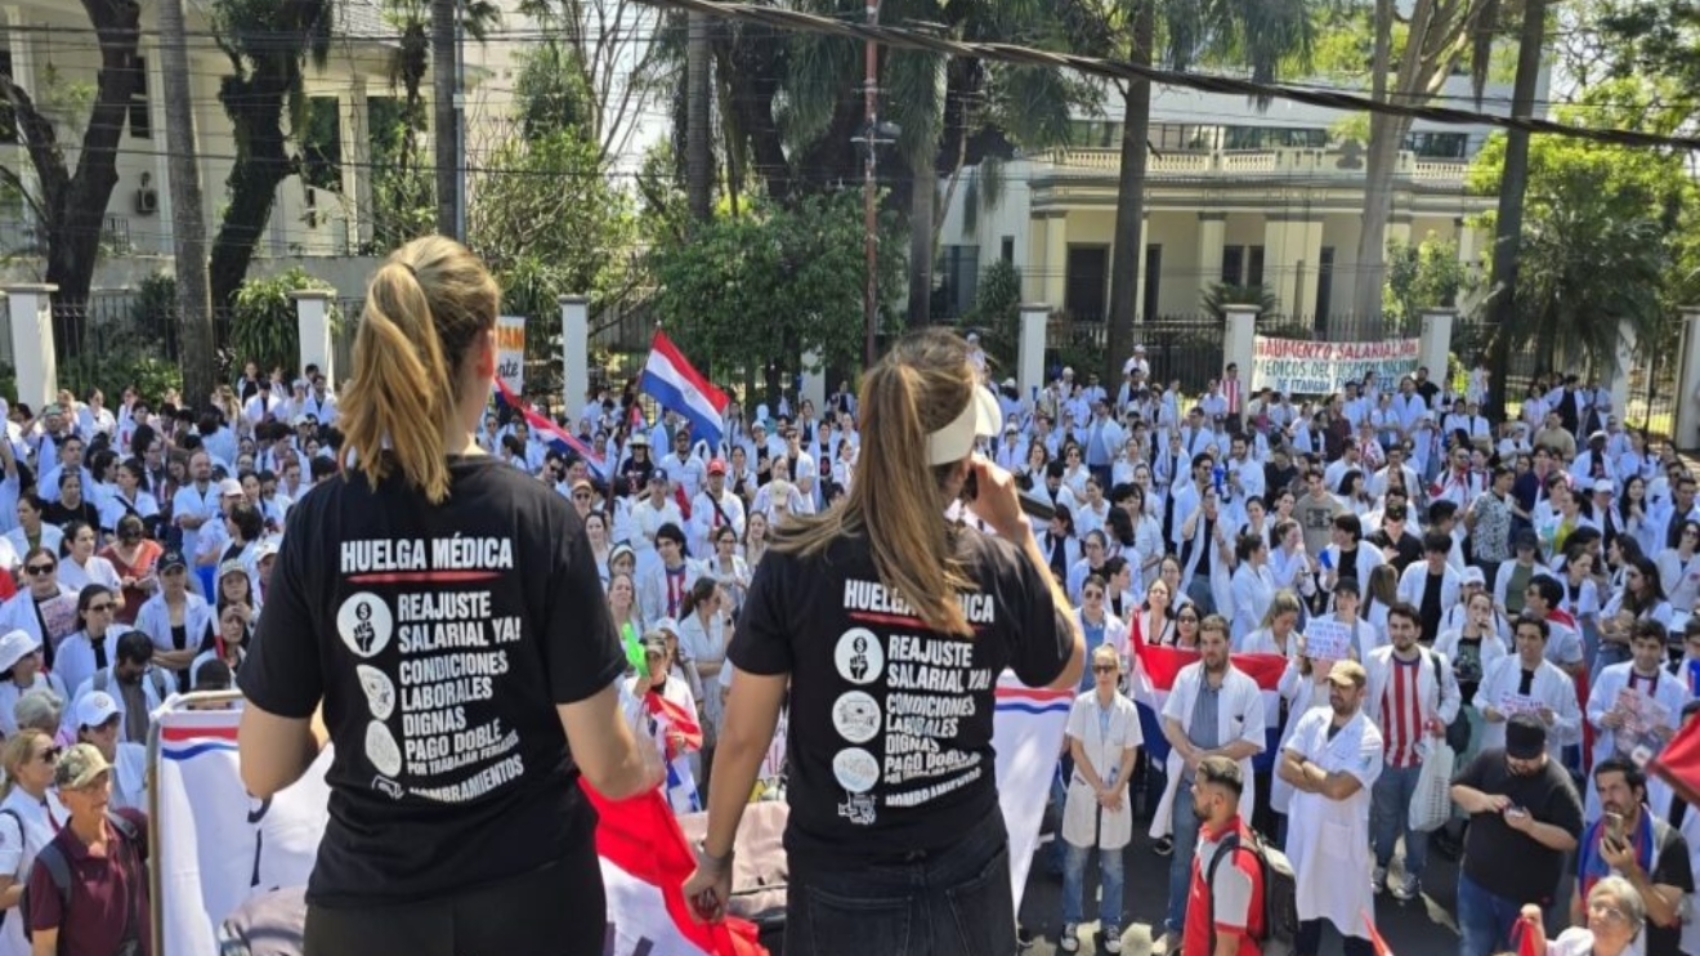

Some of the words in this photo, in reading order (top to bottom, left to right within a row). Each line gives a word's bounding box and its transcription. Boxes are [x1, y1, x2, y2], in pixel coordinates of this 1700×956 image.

[341, 539, 427, 573] HUELGA
[432, 532, 513, 570] MÉDICA
[398, 591, 491, 622] REAJUSTE
[398, 621, 489, 653] SALARIAL
[493, 617, 521, 644] YA!
[888, 634, 973, 668] REAJUSTE
[400, 650, 509, 686] CONDICIONES
[886, 663, 964, 693] SALARIAL
[967, 668, 992, 690] YA!
[402, 676, 493, 711] LABORALES
[886, 693, 976, 717] CONDICIONES
[403, 706, 466, 737] DIGNAS
[886, 713, 958, 738] LABORALES
[405, 735, 450, 761] PAGO
[454, 718, 502, 753] DOBLE
[885, 733, 940, 754] DIGNAS
[407, 761, 427, 776] POR
[408, 753, 524, 802] MBRAMIENTOS
[884, 752, 923, 773] PAGO
